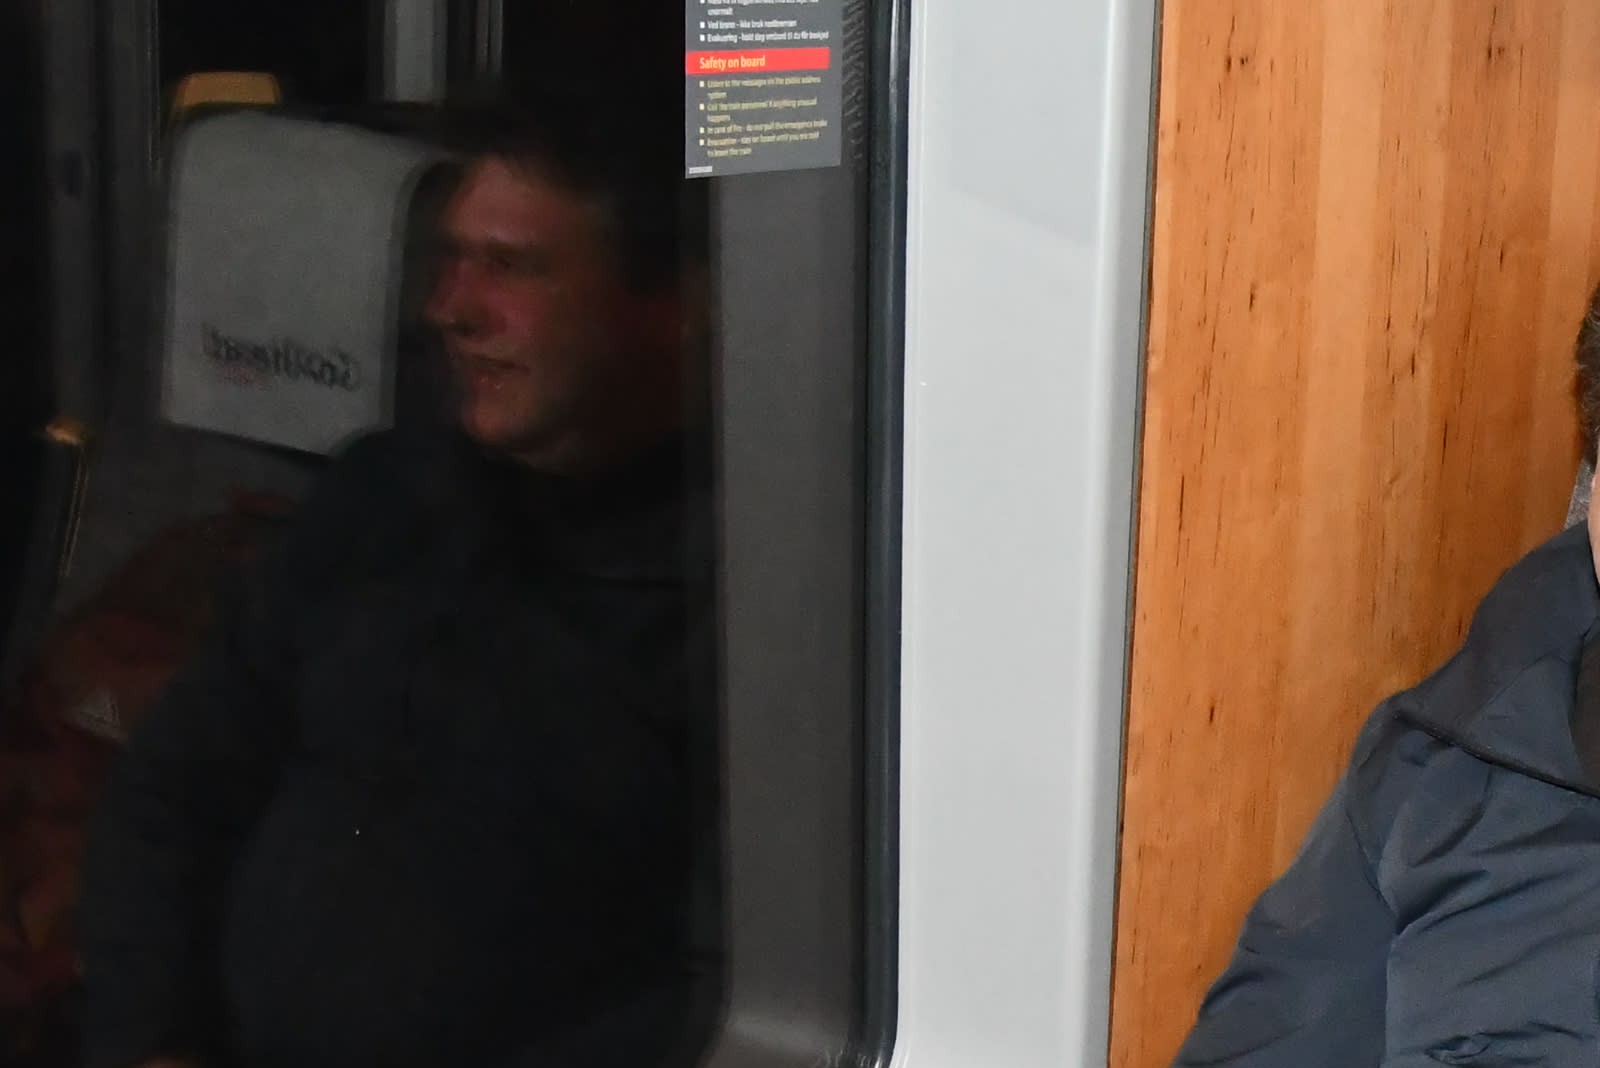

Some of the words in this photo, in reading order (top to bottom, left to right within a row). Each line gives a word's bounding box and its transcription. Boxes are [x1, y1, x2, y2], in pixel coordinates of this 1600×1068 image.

[700, 57, 727, 71] Safety
[728, 58, 739, 69] on
[740, 56, 766, 68] board
